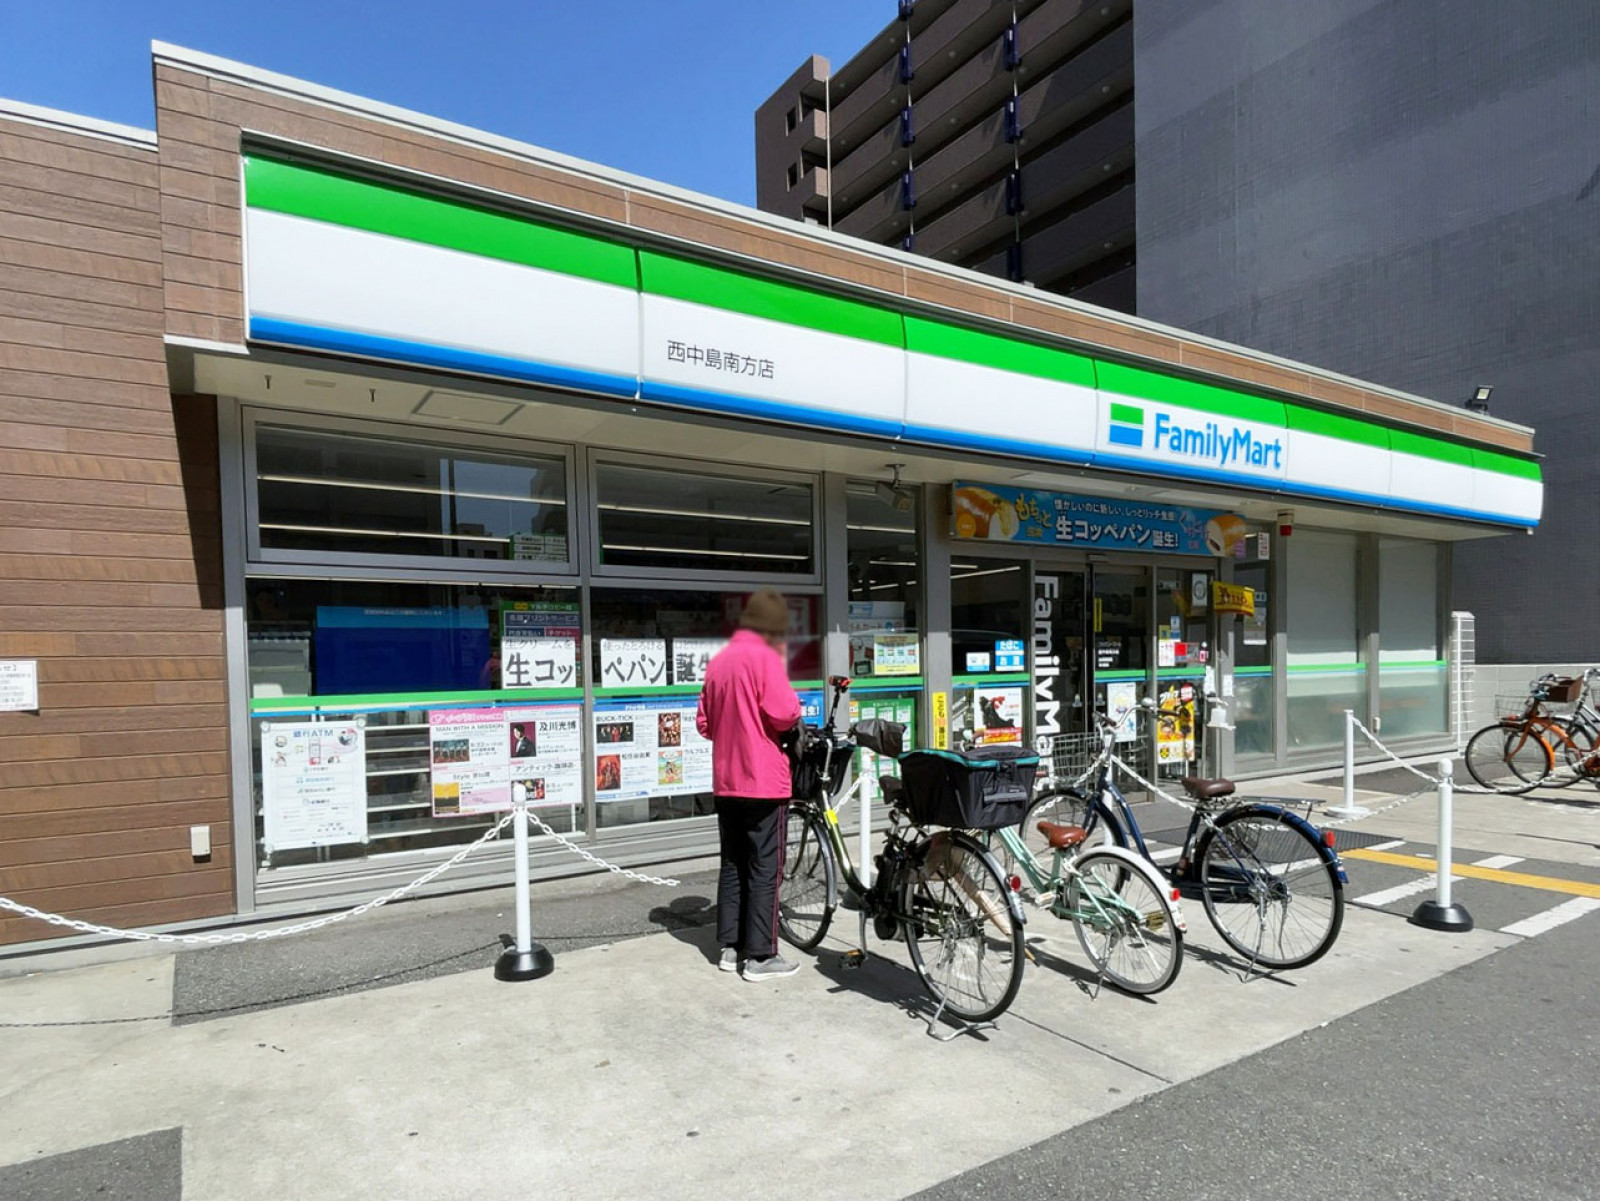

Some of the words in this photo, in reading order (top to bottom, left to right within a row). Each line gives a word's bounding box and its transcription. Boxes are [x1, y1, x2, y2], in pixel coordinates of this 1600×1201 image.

[667, 340, 775, 379] 西中島南方店
[1154, 412, 1282, 469] FamilyMart
[506, 652, 573, 686] 生コッ
[604, 653, 665, 684] ペパン
